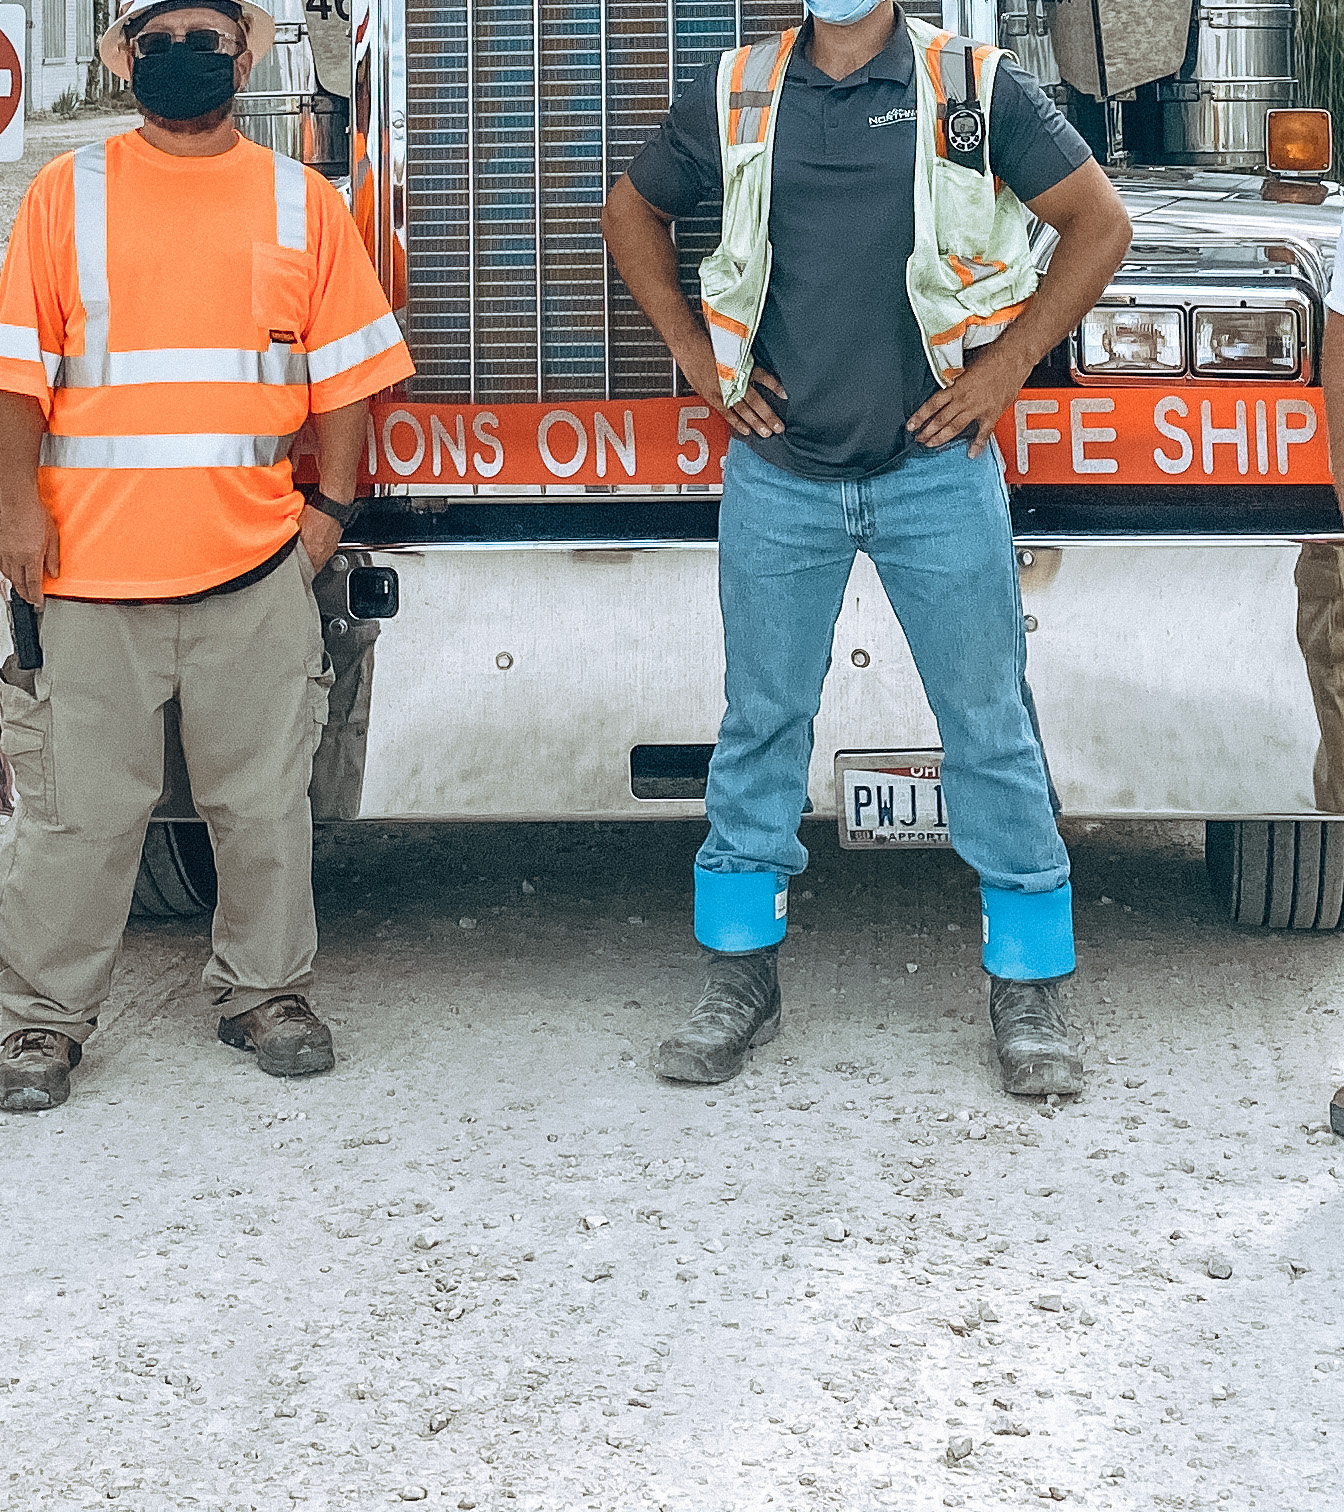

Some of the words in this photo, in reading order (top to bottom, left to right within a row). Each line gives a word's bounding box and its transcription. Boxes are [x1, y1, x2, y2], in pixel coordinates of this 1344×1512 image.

[367, 408, 504, 477] IONS
[537, 407, 638, 478] ON
[1014, 397, 1119, 475] FE
[1154, 395, 1318, 476] SHIP
[854, 785, 917, 827] PWJ
[933, 784, 947, 828] 1
[888, 832, 949, 841] APPORTI
